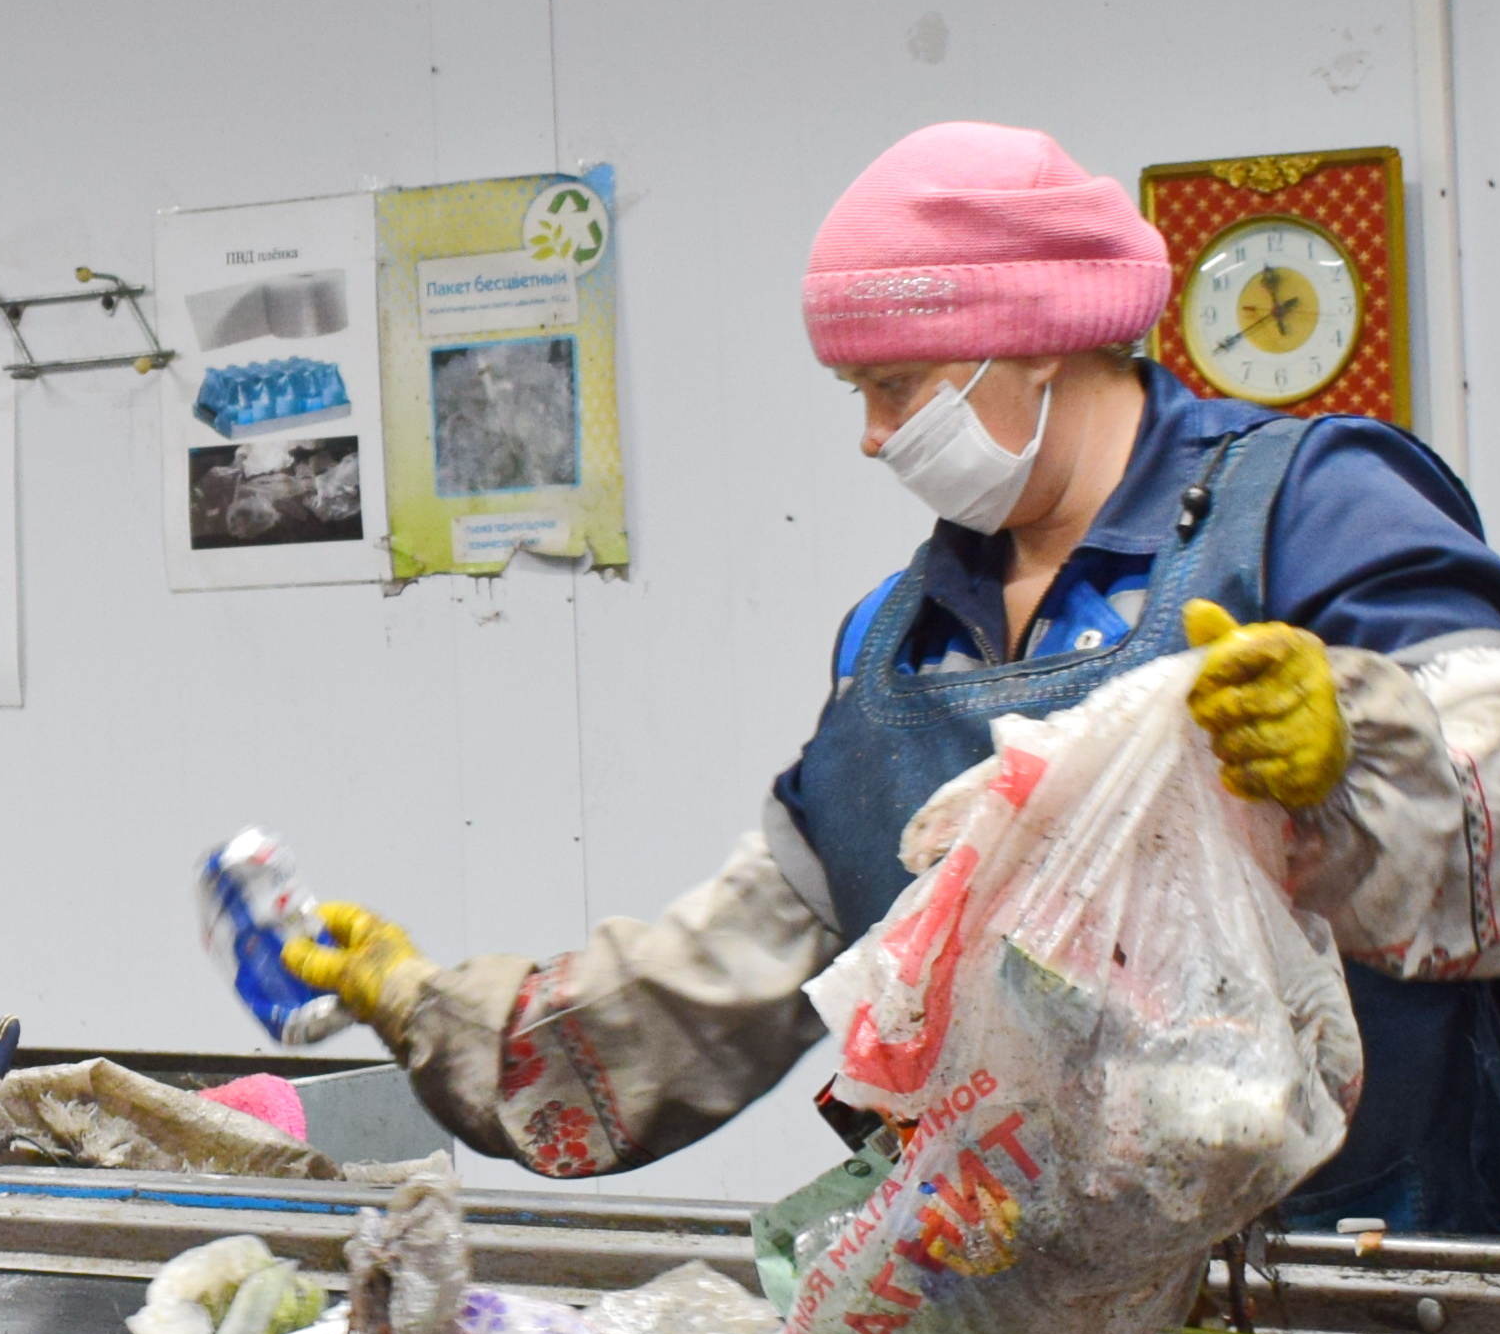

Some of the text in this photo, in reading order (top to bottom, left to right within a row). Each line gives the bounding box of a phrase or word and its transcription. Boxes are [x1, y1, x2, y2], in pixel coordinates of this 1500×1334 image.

[1267, 233, 1284, 253] 12
[226, 250, 254, 265] ПВД
[1236, 247, 1247, 263] 11
[426, 269, 568, 297] Пакет бесцветный
[1213, 276, 1229, 292] 10
[1331, 267, 1342, 282] 2
[1204, 305, 1217, 325] 9
[1329, 329, 1342, 348] 4
[1242, 361, 1253, 381] 7
[1310, 356, 1322, 374] 5
[1274, 367, 1288, 387] 6
